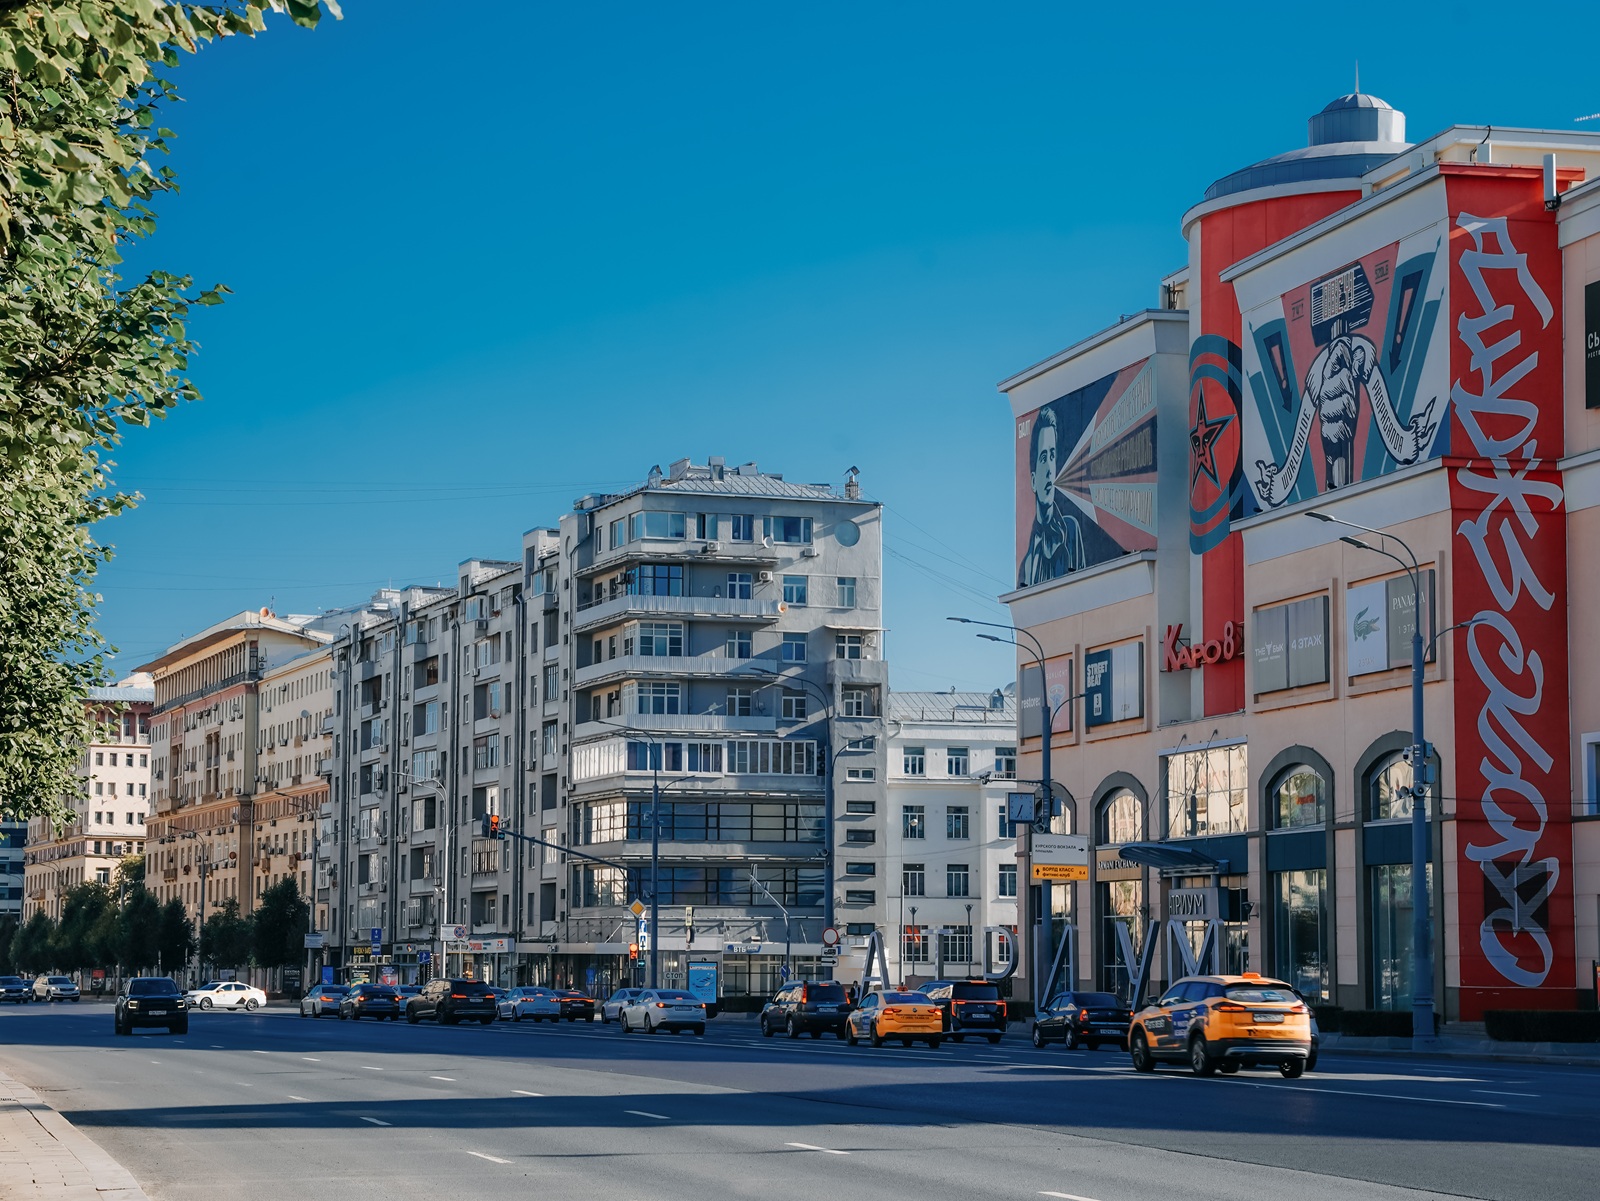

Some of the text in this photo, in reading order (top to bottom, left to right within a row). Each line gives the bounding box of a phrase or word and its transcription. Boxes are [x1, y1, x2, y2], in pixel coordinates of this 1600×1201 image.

[1371, 379, 1404, 455] PROPAGANDA
[1281, 408, 1311, 490] WORLDWIDE
[1223, 620, 1237, 661] 8
[1291, 633, 1322, 651] 4 ЭТАЖ
[1254, 647, 1266, 657] THE
[1086, 660, 1109, 676] STREET
[1086, 674, 1102, 689] BEAT
[1169, 893, 1206, 915] АТРИУМ
[733, 945, 747, 953] ВТБ
